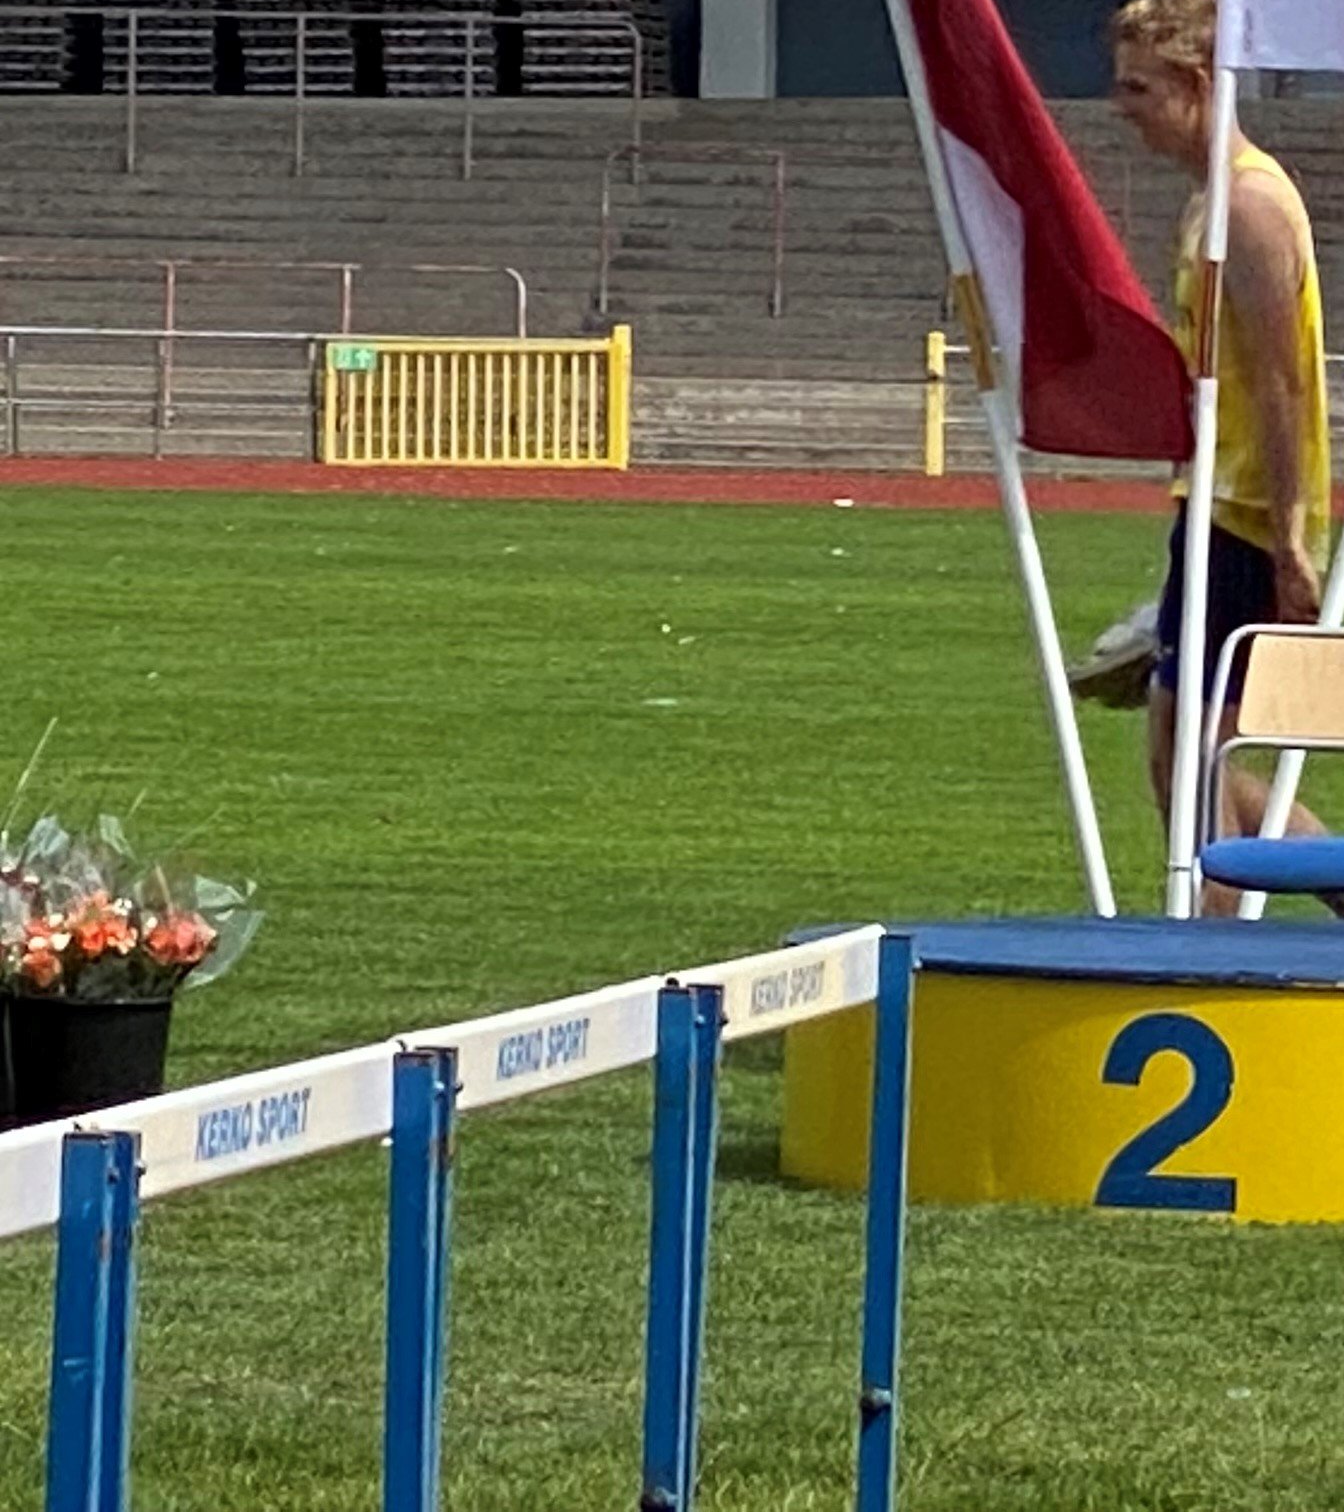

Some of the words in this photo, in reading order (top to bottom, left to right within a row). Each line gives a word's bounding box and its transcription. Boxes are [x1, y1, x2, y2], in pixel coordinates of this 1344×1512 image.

[545, 1017, 590, 1069] SPORT
[193, 1101, 252, 1163] KERKO
[257, 1087, 312, 1147] SPORT
[1094, 1012, 1238, 1213] 2
